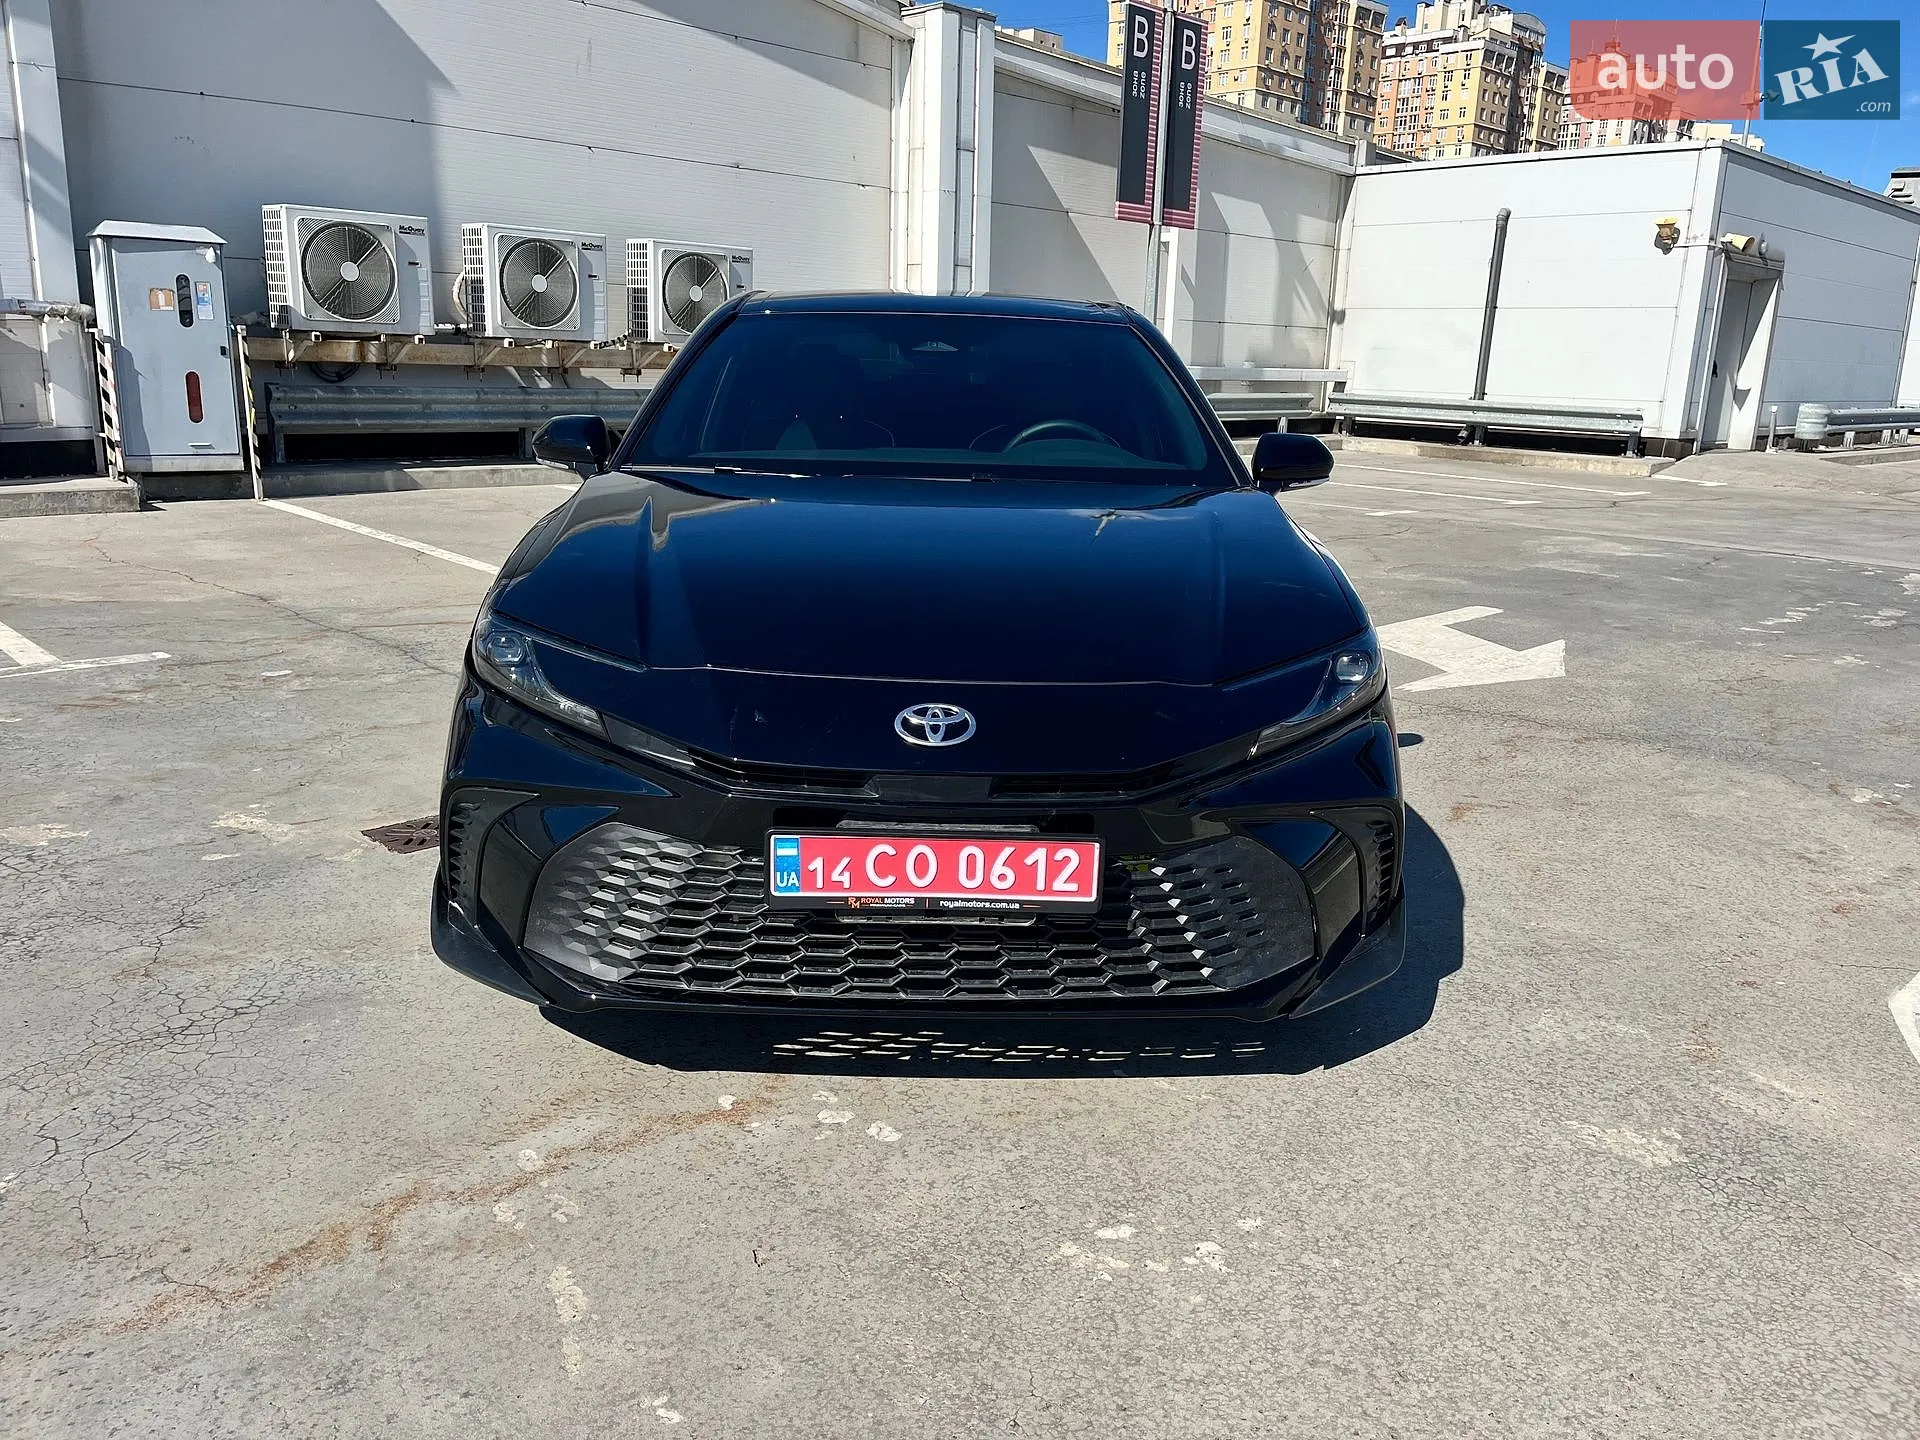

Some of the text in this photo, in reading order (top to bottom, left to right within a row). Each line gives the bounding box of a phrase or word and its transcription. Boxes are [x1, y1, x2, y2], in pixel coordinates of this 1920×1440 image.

[399, 225, 425, 233] McQuay
[807, 843, 1081, 892] 14 CO 0612
[776, 871, 800, 887] UA
[939, 900, 1020, 909] royalmotors.com.ua
